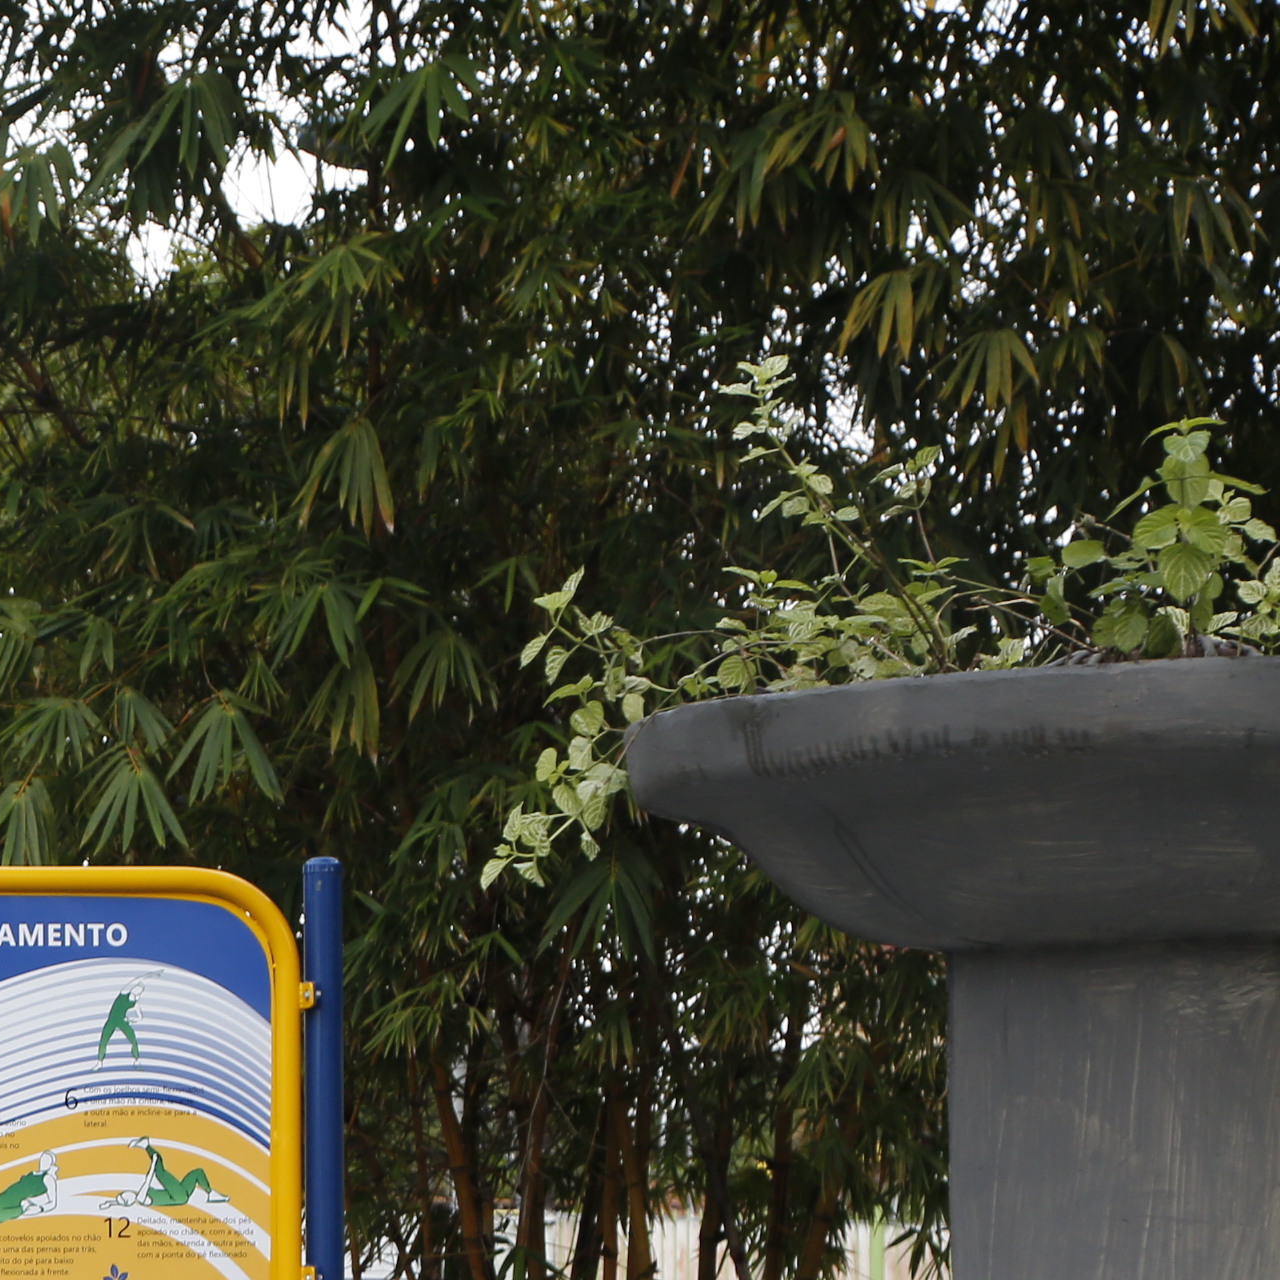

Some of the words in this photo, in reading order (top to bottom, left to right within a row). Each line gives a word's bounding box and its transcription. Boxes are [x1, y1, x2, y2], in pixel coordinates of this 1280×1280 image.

[65, 1088, 78, 1109] 6
[104, 1217, 131, 1238] 12
[36, 1235, 69, 1243] apoiados
[24, 1258, 34, 1266] pé
